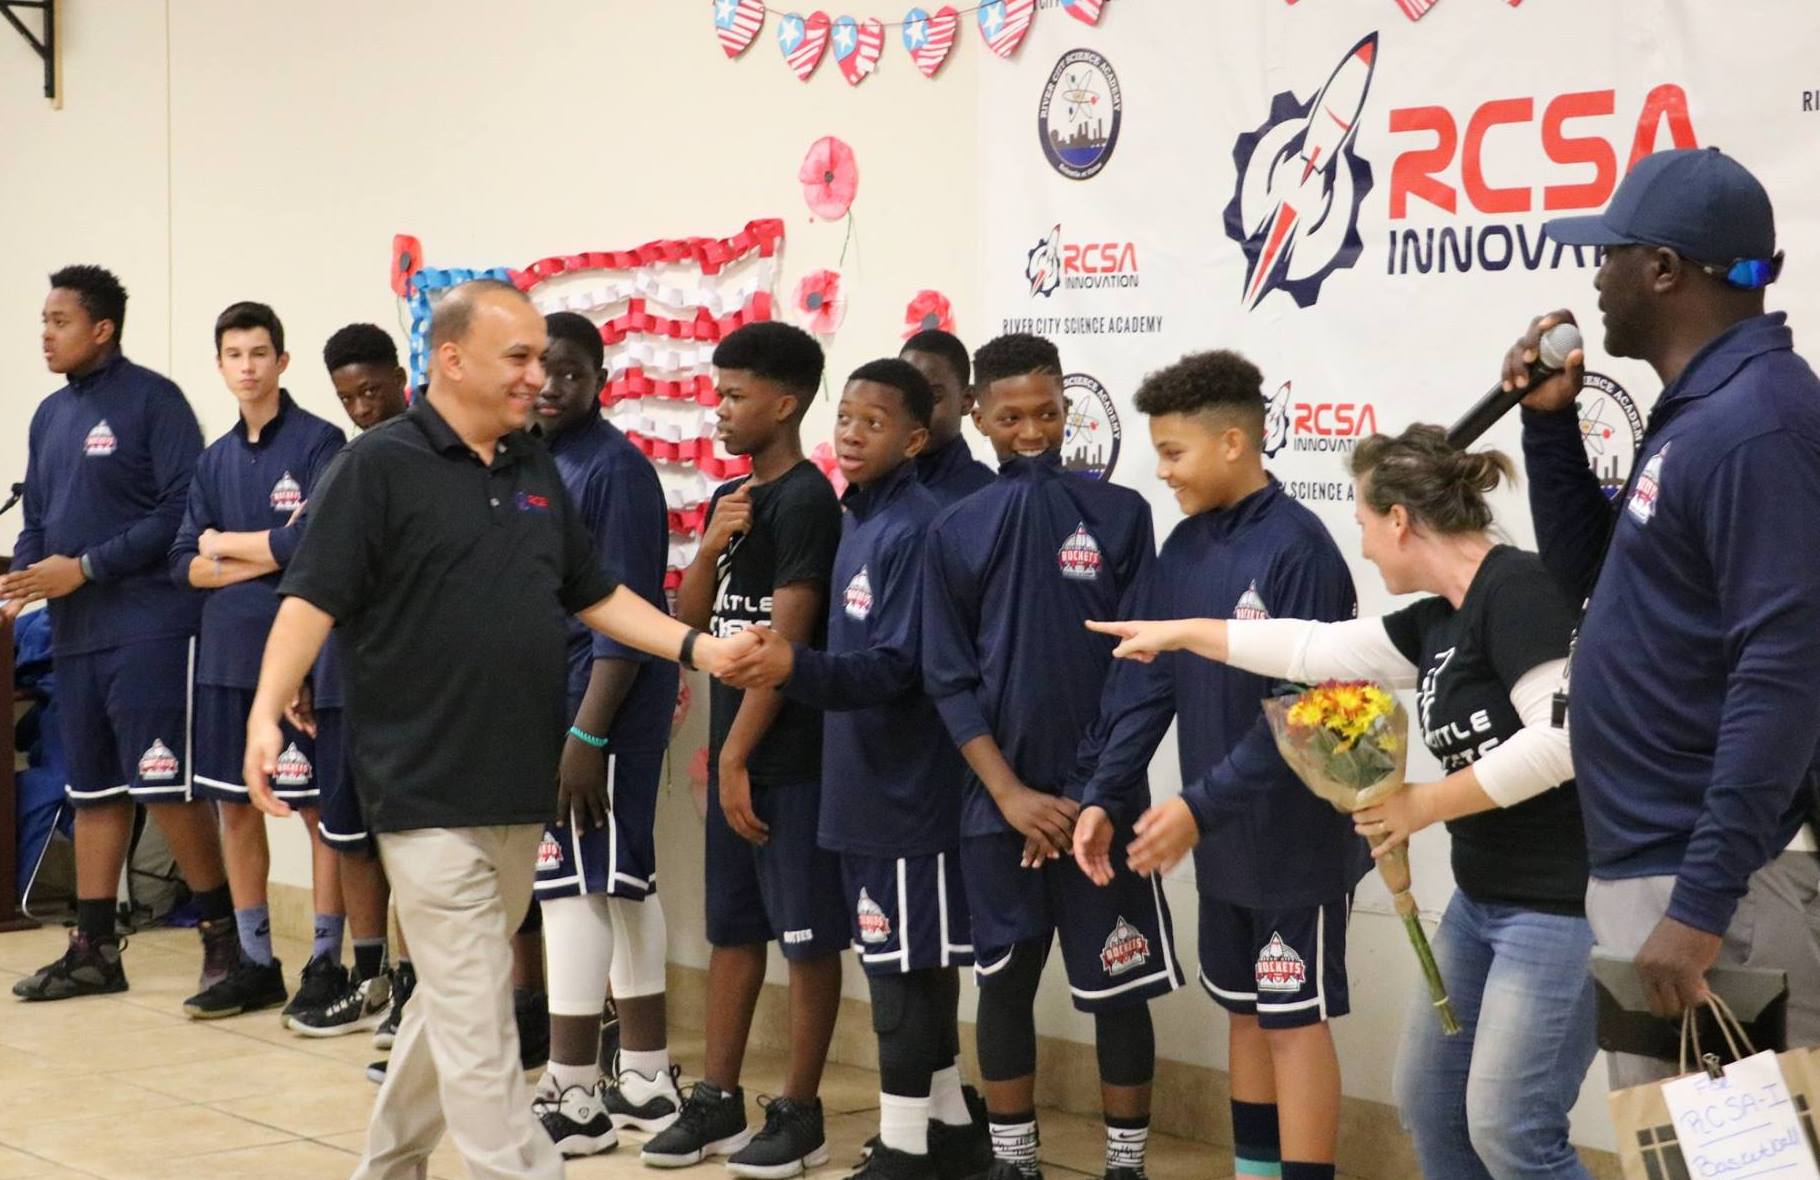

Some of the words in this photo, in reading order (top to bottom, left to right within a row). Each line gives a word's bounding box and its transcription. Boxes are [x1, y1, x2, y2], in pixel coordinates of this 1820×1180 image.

[1099, 61, 1121, 112] ACADEMY
[1389, 83, 1699, 219] RCSA
[1063, 242, 1138, 274] RCSA
[1387, 223, 1602, 275] INNOVA
[1065, 275, 1139, 290] INNOVATION
[1036, 318, 1062, 335] CITY
[1064, 317, 1105, 335] SCIENCE
[1108, 315, 1163, 334] ACADEMY
[1097, 389, 1121, 440] ACADEMY
[1294, 403, 1376, 436] RCSA
[1291, 482, 1342, 501] SCIENCE
[1257, 960, 1302, 975] ROCKETS
